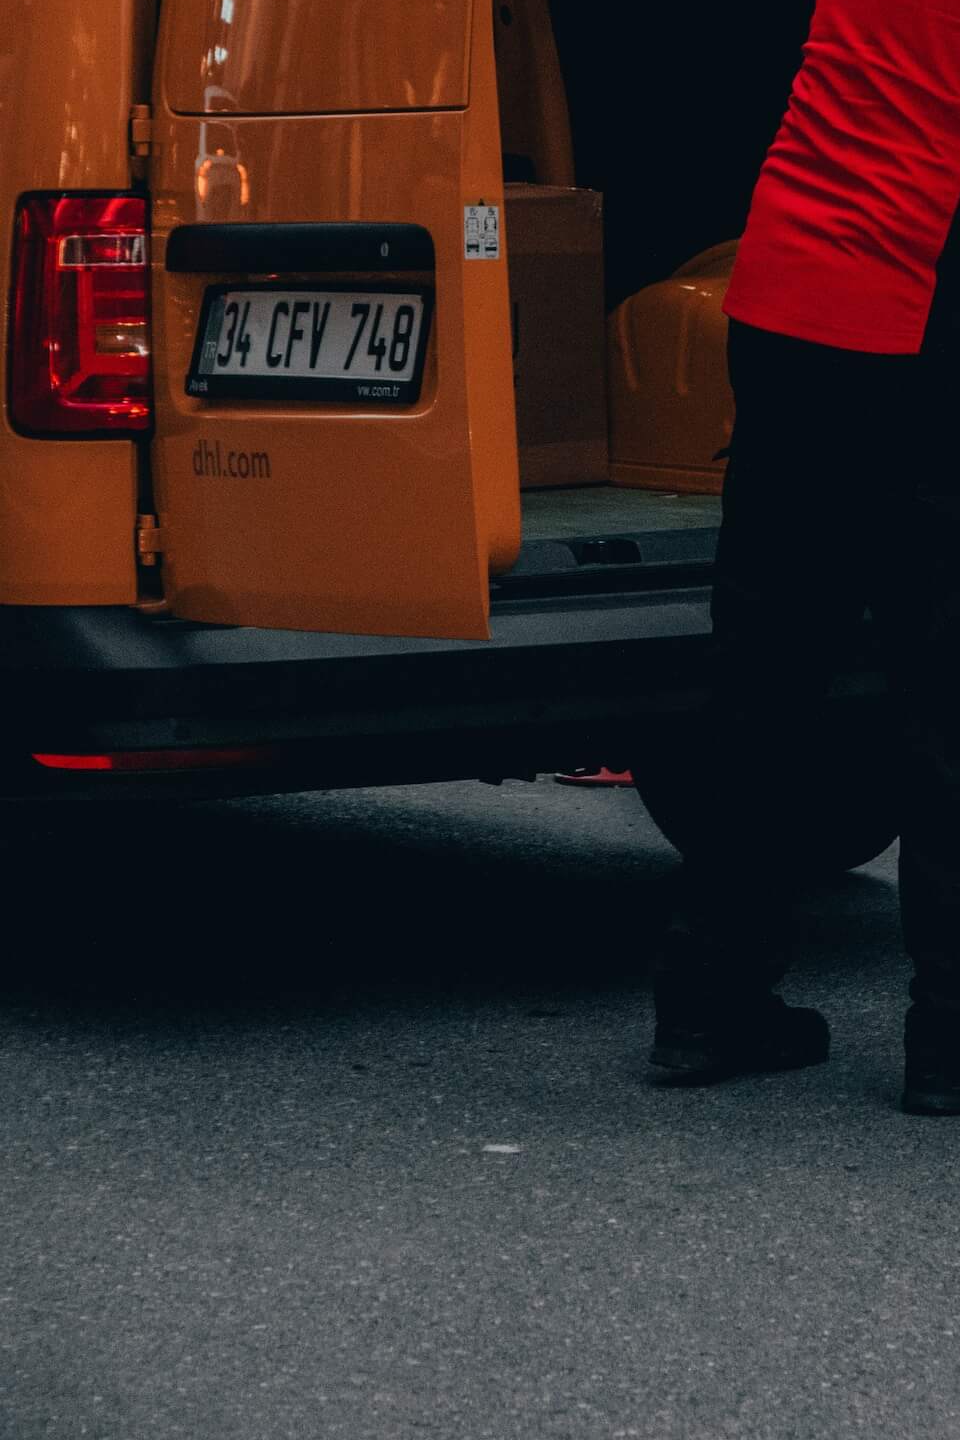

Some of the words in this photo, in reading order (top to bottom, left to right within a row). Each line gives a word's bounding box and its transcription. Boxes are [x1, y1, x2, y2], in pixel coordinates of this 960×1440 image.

[216, 301, 251, 368] 34
[265, 301, 332, 370] CFV
[343, 303, 415, 373] 748
[356, 384, 401, 398] vw.com.tr
[192, 439, 271, 479] dhl.com
